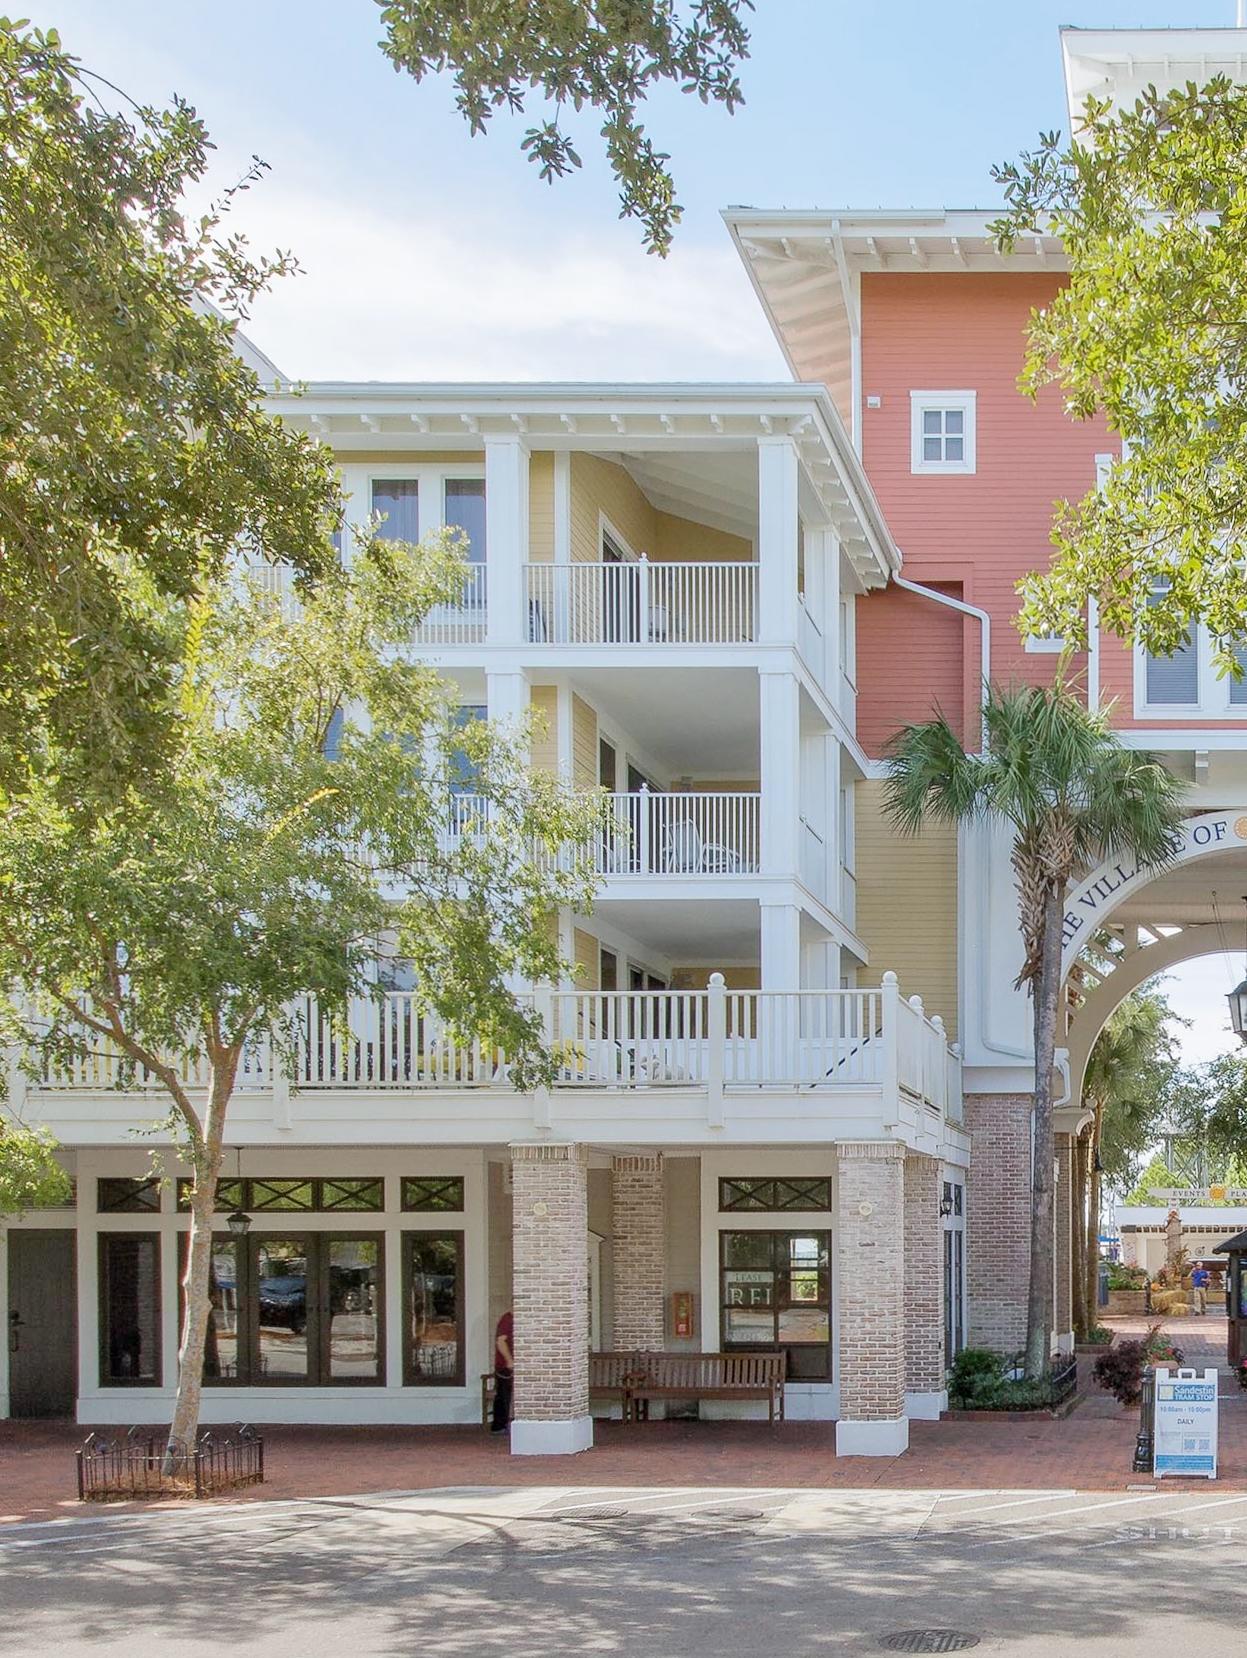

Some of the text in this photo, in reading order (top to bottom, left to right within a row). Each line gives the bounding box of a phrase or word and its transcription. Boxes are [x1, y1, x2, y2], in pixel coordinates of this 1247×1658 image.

[1061, 911, 1084, 949] HE
[1078, 833, 1186, 908] VILLAE
[1193, 820, 1227, 845] OF
[1174, 1384, 1214, 1395] Sandestin
